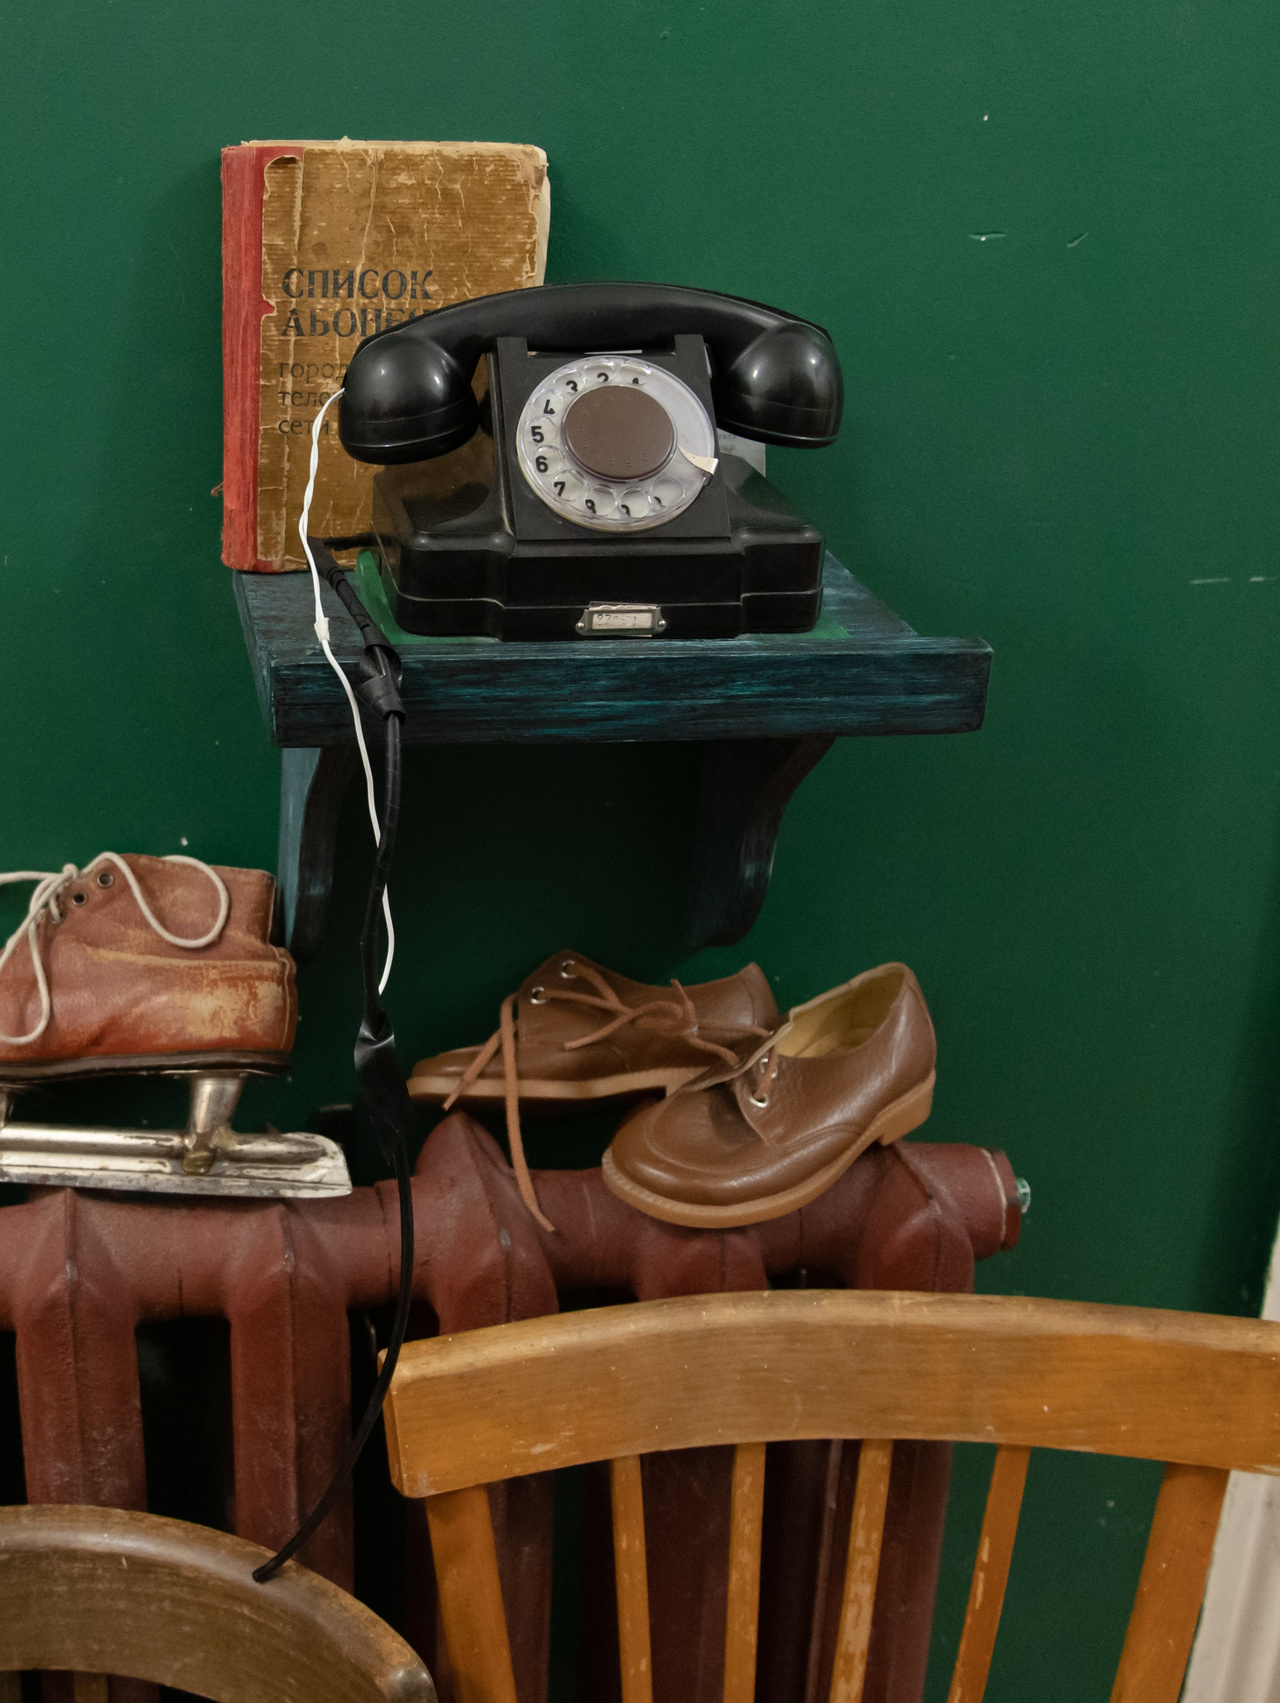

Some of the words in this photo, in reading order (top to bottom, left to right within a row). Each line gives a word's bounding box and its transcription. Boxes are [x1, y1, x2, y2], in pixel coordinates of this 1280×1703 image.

[282, 267, 433, 300] СПИСОК
[281, 308, 434, 337] АБОНЕ
[544, 399, 555, 415] 4
[531, 426, 544, 443] 5
[536, 456, 549, 473] 6
[554, 481, 566, 497] 7
